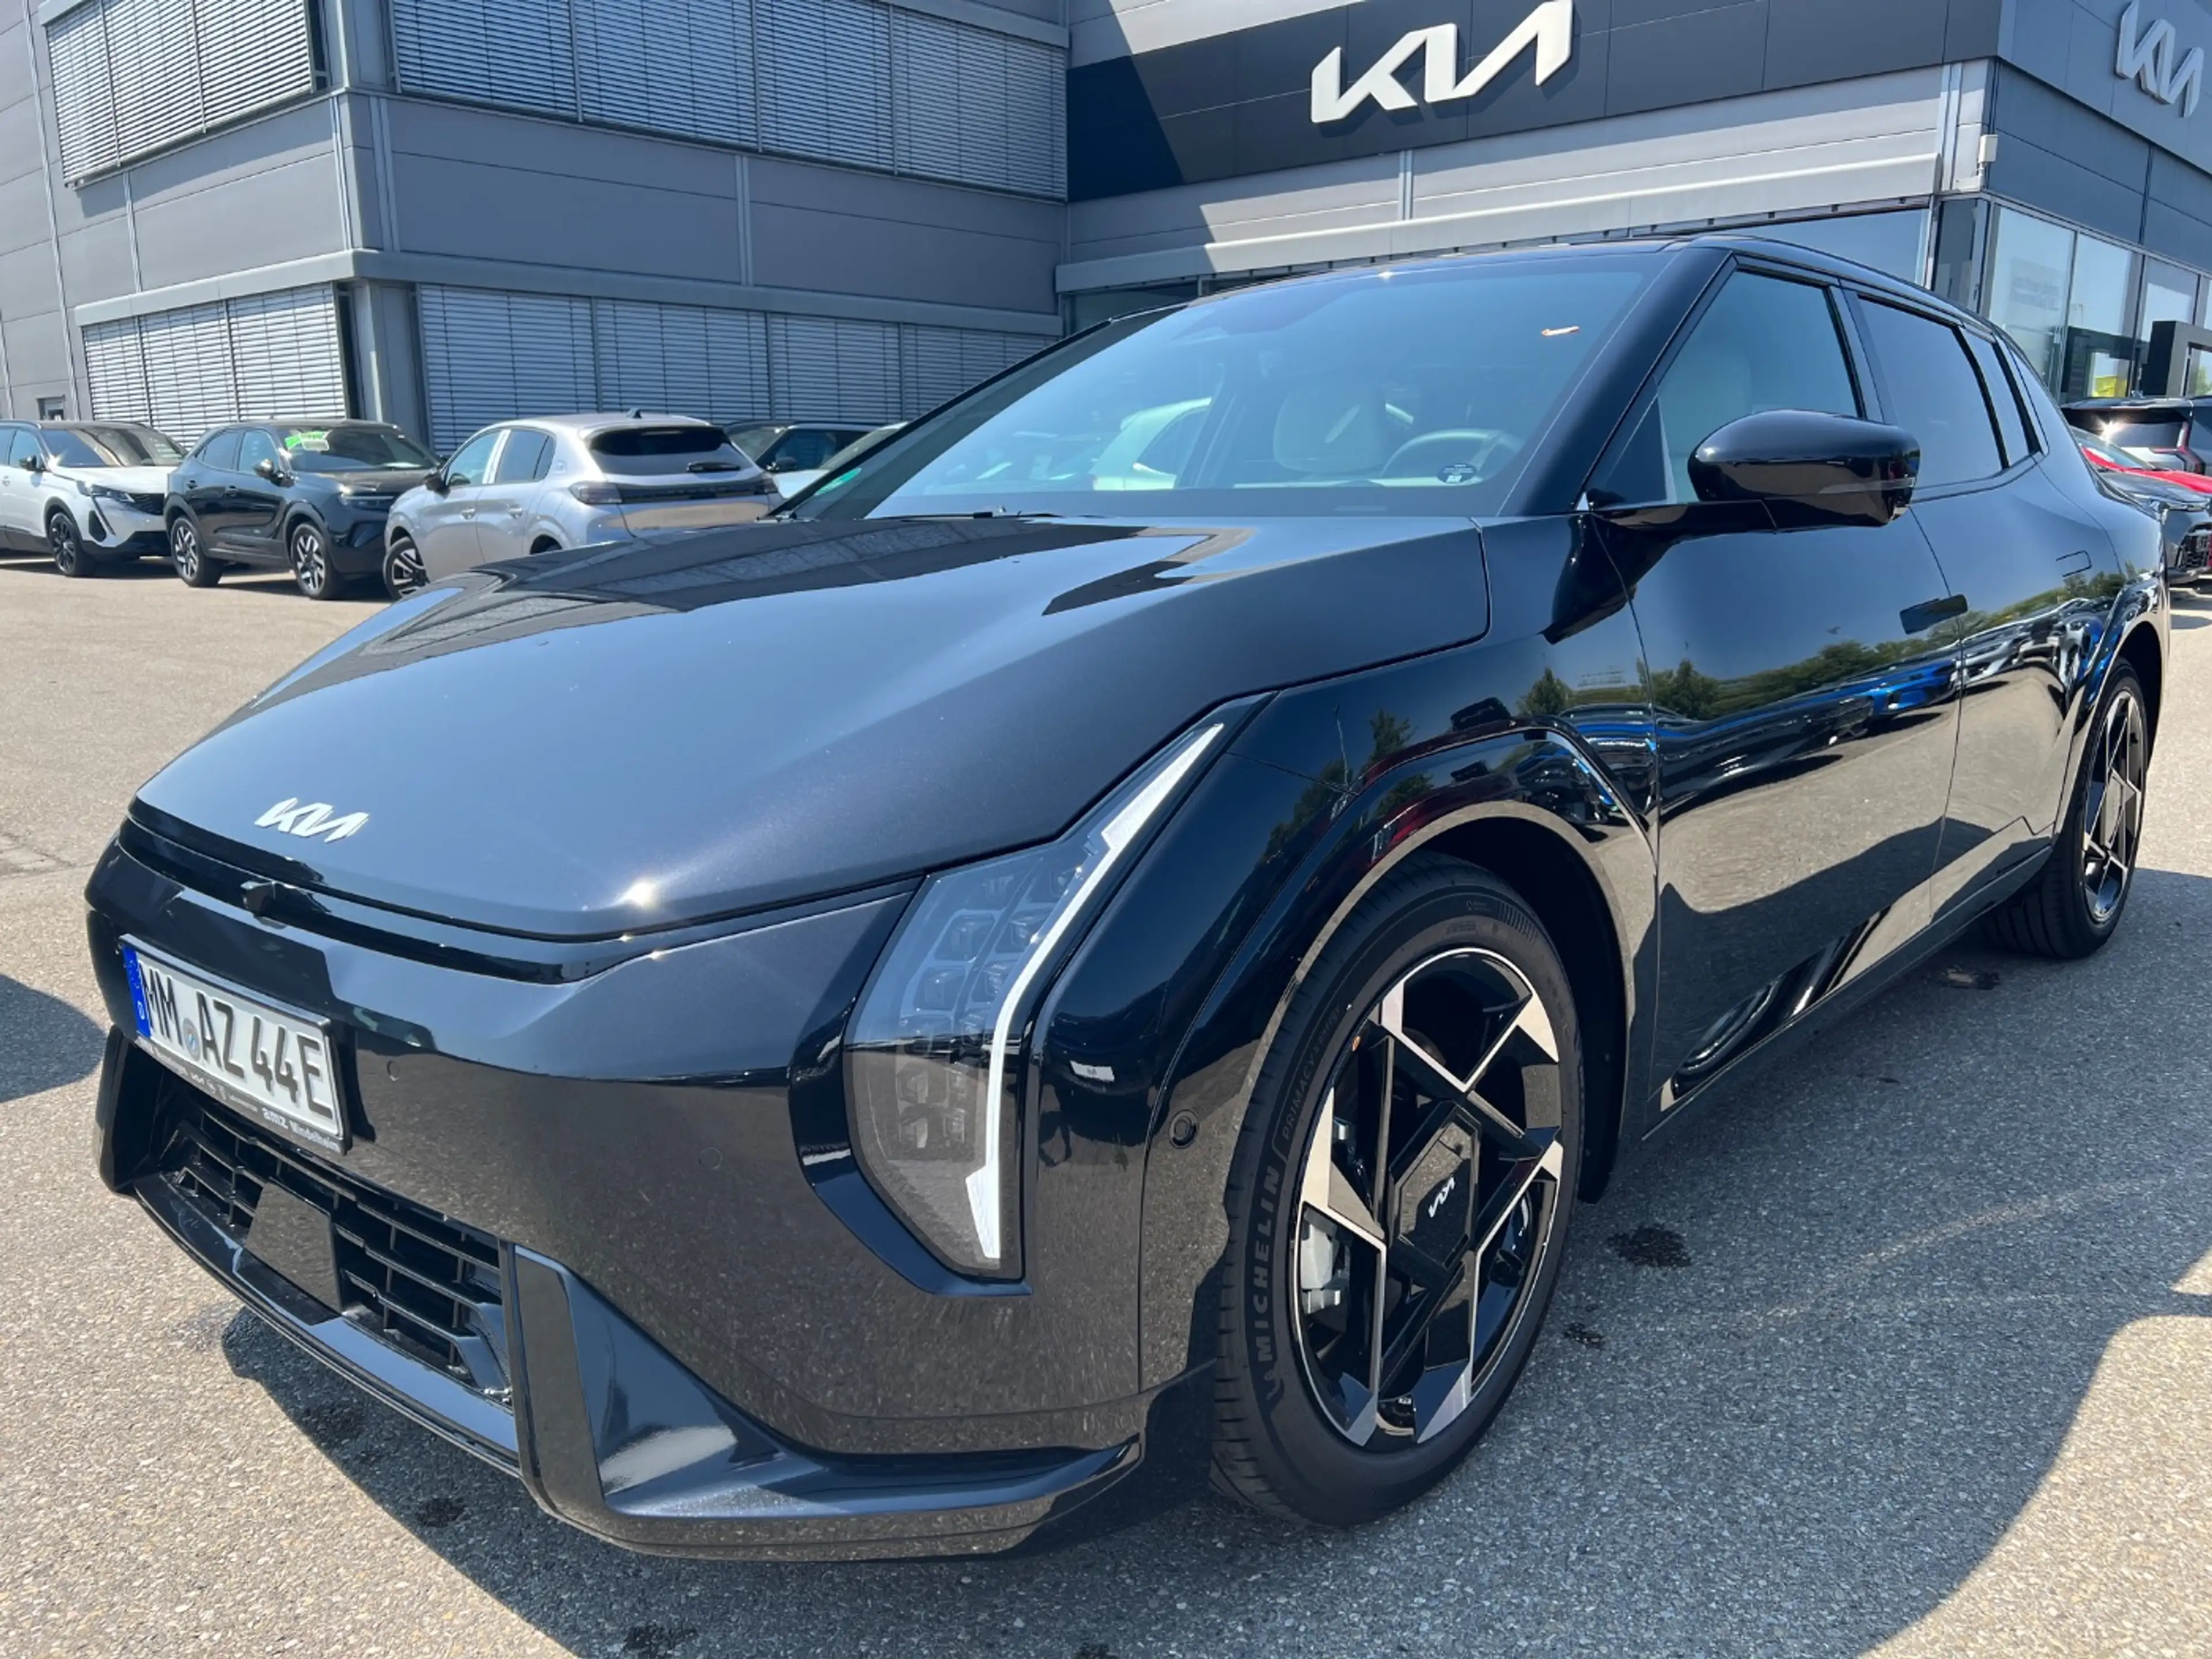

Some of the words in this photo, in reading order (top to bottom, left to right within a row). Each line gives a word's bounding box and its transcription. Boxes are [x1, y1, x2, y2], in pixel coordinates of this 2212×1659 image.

[1311, 0, 1573, 123] KIA
[254, 797, 369, 843] KIA
[196, 990, 245, 1080] AZ
[251, 1014, 333, 1120] 44E
[1252, 1167, 1280, 1362] MICHELIN
